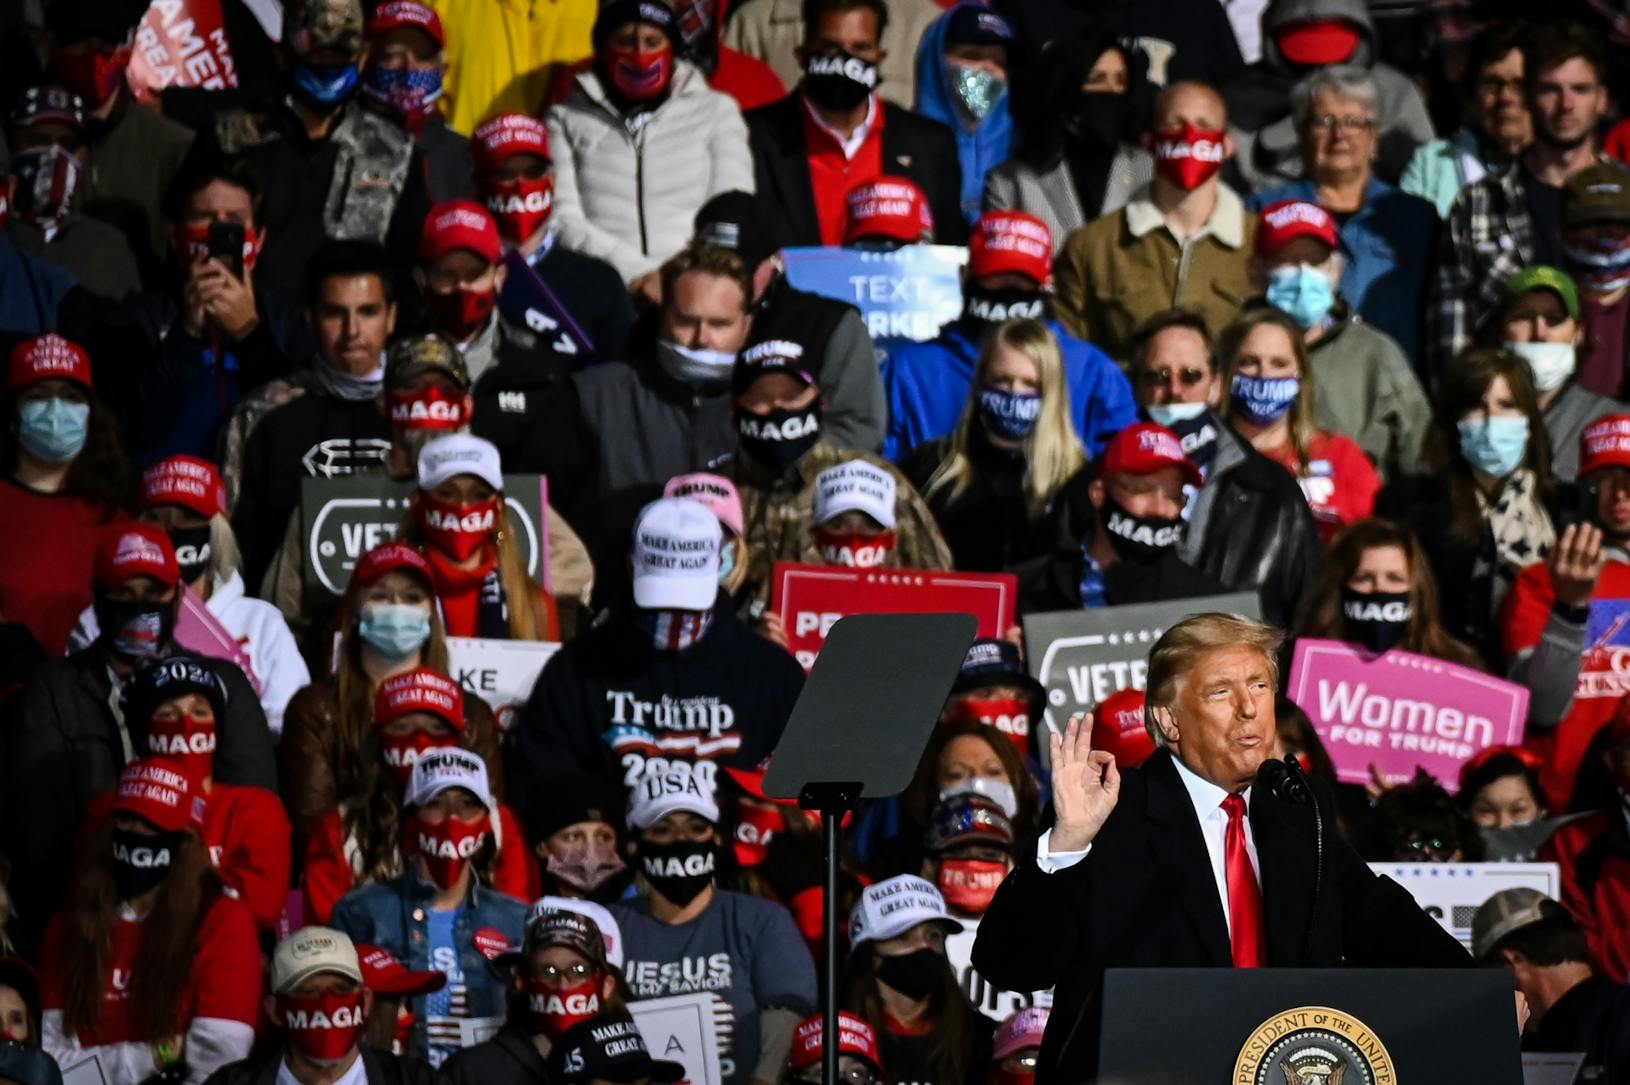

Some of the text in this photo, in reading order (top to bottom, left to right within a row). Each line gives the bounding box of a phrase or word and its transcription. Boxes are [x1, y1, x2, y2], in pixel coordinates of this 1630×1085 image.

[808, 55, 877, 89] MAGA
[1155, 139, 1223, 162] MAGA
[849, 274, 928, 303] TEXT
[1231, 375, 1299, 401] TRUMP
[391, 399, 460, 421] MAGA
[739, 413, 819, 442] MAGA
[1180, 424, 1218, 455] GA
[425, 509, 495, 533] MAGA
[605, 689, 735, 739] Trump
[1318, 678, 1495, 749] Women
[148, 731, 217, 755] MAGA
[1329, 724, 1476, 760] FOR TRUMP
[383, 746, 420, 767] MA
[420, 753, 480, 774] TRUMP
[647, 773, 703, 800] USA
[418, 831, 485, 860] MAGA
[643, 851, 715, 878] MAGA
[869, 881, 902, 904] MAKE
[880, 898, 915, 917] GREAT
[529, 992, 599, 1016] MAGA
[285, 1005, 364, 1030] MAGA
[591, 1021, 625, 1043] MAKE
[604, 1036, 639, 1058] GREAT
[1238, 1012, 1391, 1085] PRESIDENT OF THE UNITE
